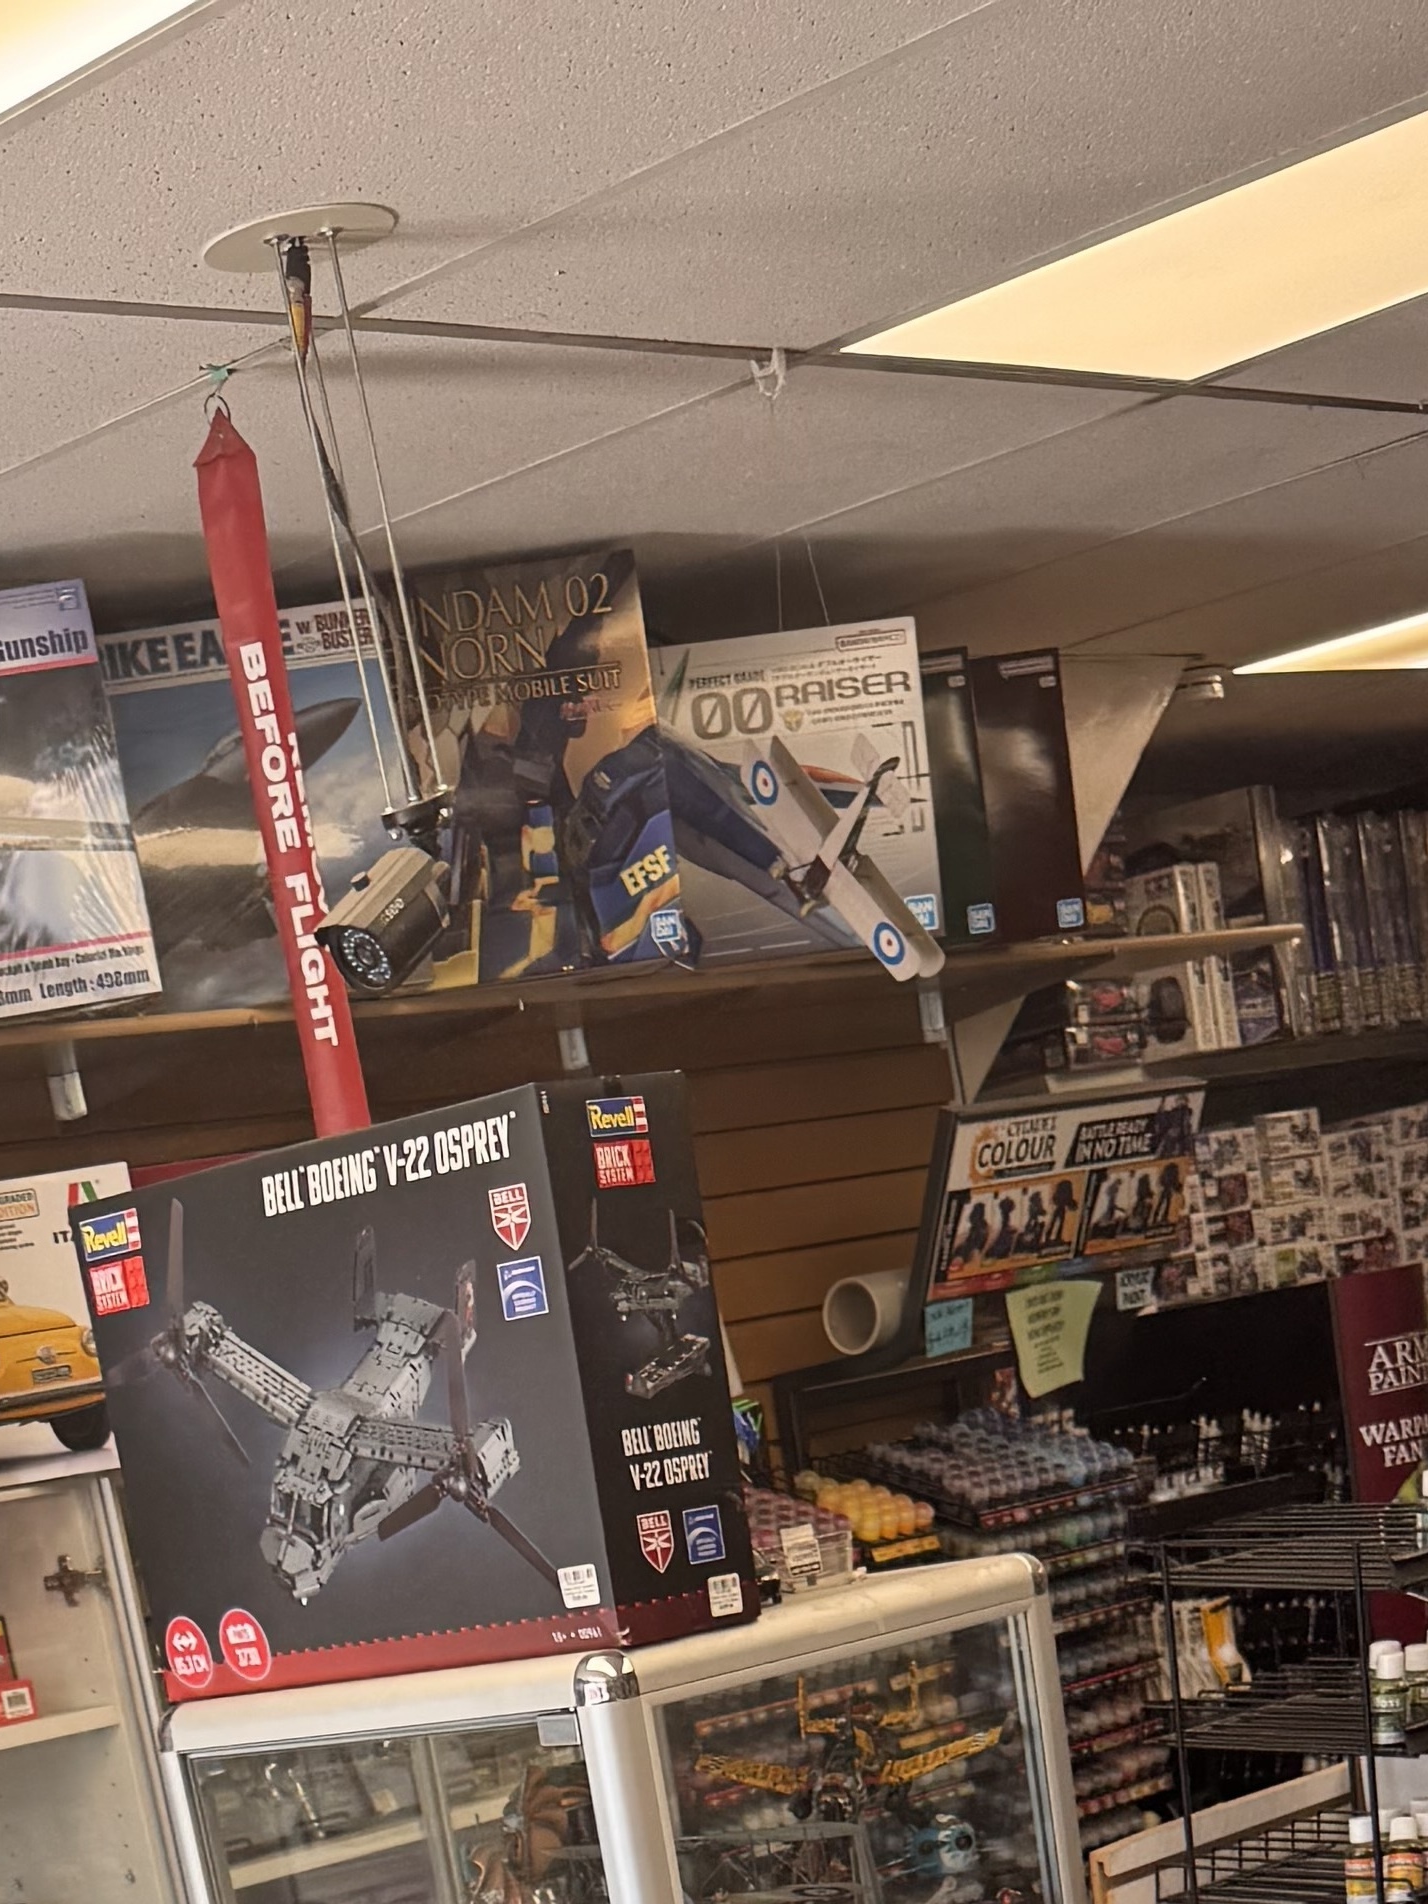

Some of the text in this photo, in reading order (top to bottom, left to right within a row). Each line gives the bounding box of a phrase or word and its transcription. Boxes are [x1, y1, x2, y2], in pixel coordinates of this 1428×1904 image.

[565, 572, 613, 619] 02
[575, 669, 621, 692] SUIT
[774, 669, 913, 709] RAISER
[239, 643, 302, 854] BEFORE
[284, 872, 340, 1048] FLIGHT
[619, 845, 671, 897] EFSF
[39, 979, 87, 1003] Length
[591, 1103, 636, 1130] Revell
[597, 1142, 630, 1168] BRICK
[978, 1133, 1058, 1168] COLOUR
[1079, 1133, 1153, 1159] IN NO TIME
[263, 1111, 516, 1218] BELL BOEING V-22 OSPREY
[599, 1165, 634, 1188] SYSTEM
[491, 1187, 524, 1205] BELL
[83, 1220, 128, 1255] Revell
[621, 1417, 702, 1457] BELL BOEING
[629, 1452, 713, 1491] V-22 OSPREY
[639, 1514, 669, 1530] BELL
